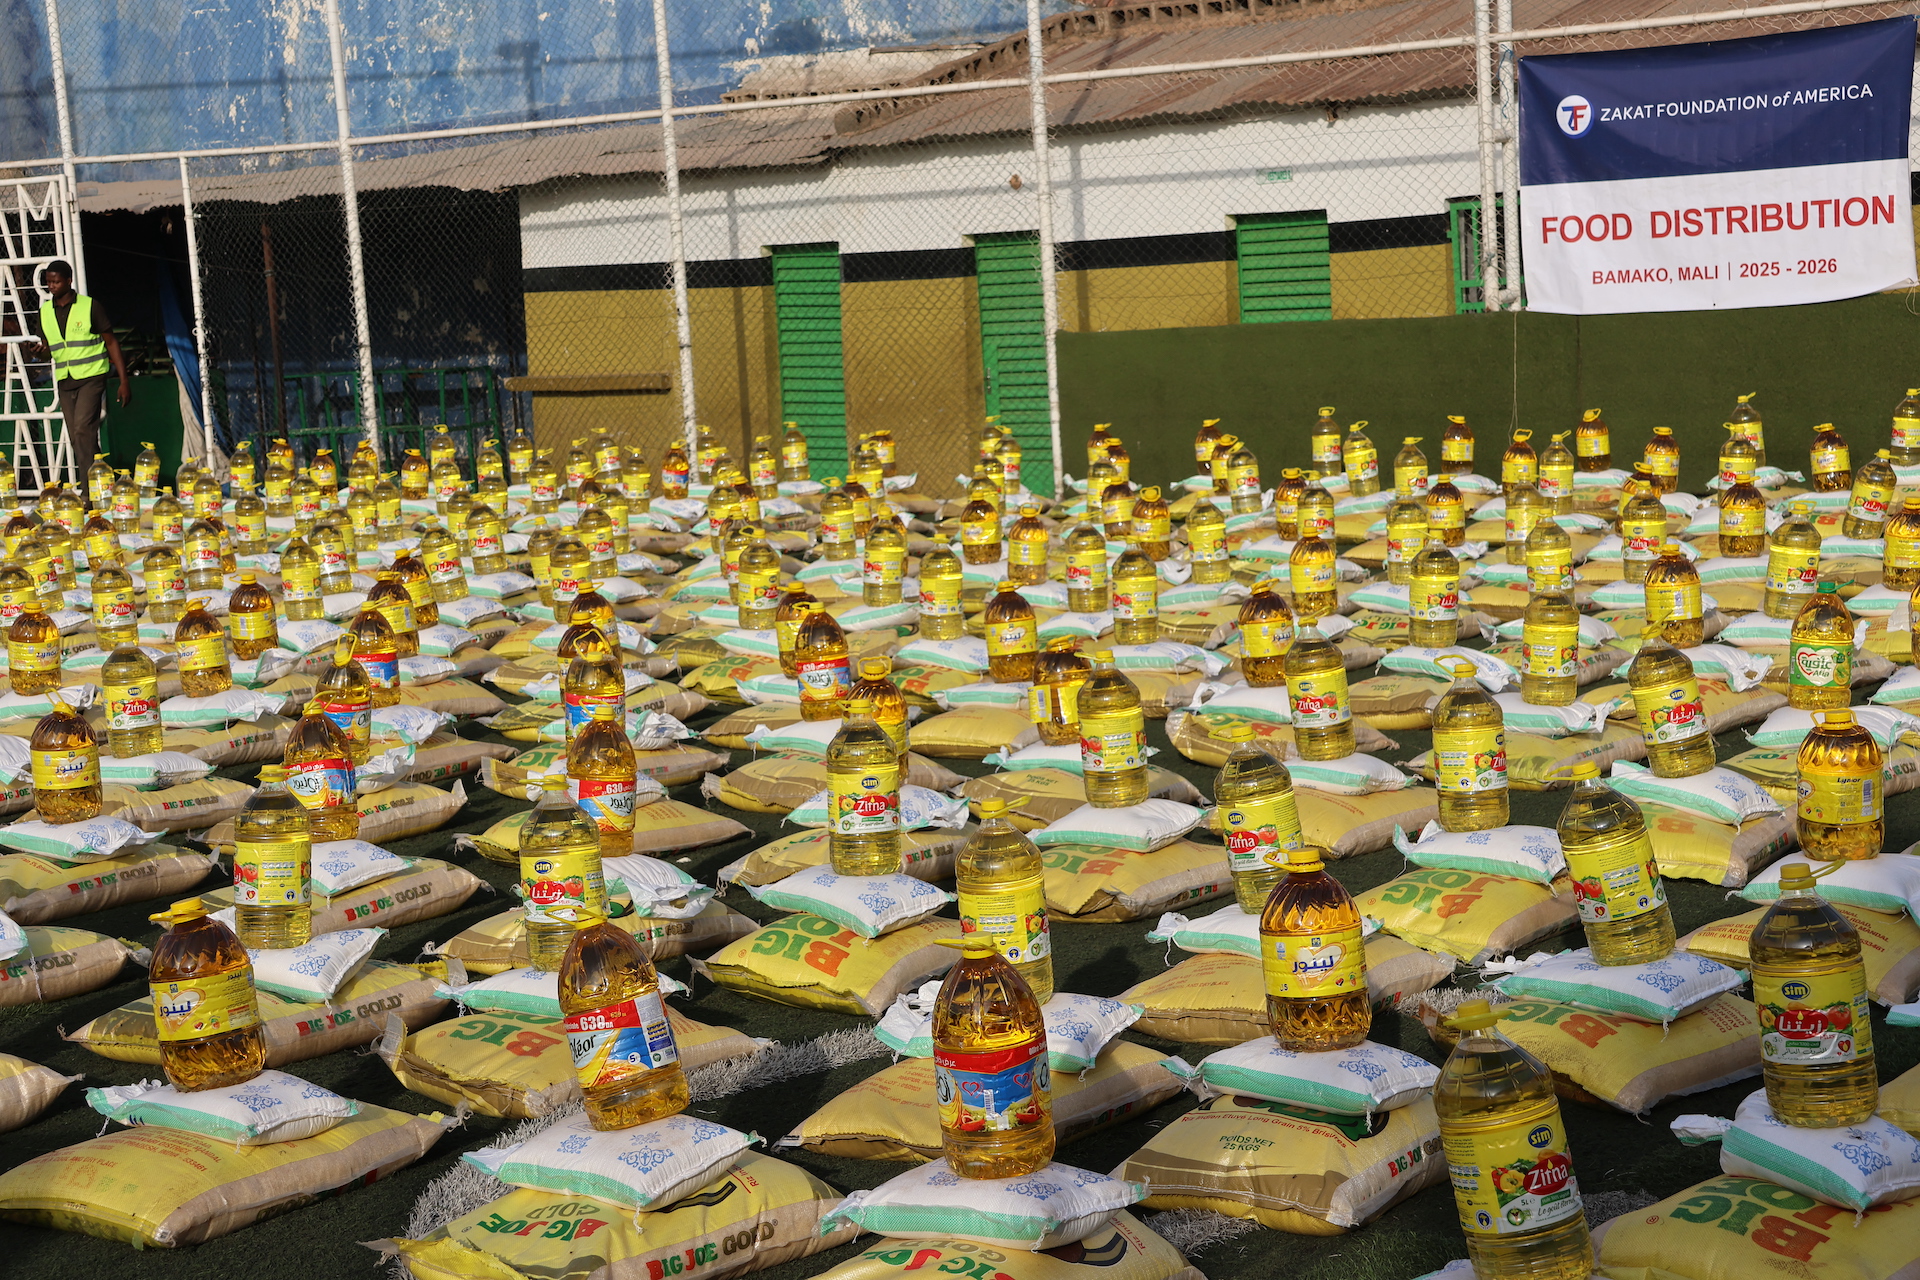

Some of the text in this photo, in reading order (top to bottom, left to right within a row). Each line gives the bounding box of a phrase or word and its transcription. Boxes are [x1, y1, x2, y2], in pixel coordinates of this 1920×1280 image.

[1600, 84, 1873, 122] ZAKAT FOUNDATION of AMERICA
[1542, 195, 1895, 244] FOOD DISTRIBUTION
[1592, 267, 1674, 285] BAMAKO,
[1678, 265, 1719, 281] MALI
[1739, 262, 1781, 278] 2025
[1797, 258, 1838, 275] 2026
[125, 704, 147, 714] Zitna
[1297, 700, 1321, 711] Zitna
[606, 783, 623, 793] 630
[862, 779, 878, 788] sim
[15, 787, 30, 798] JOE
[162, 798, 195, 810] BIG JOE
[856, 800, 885, 812] Zitna
[1229, 813, 1243, 822] sim
[1228, 836, 1256, 849] Zitna
[535, 862, 551, 871] sim
[905, 852, 920, 864] BIG
[67, 880, 94, 895] BIG
[96, 873, 118, 888] JOE
[344, 885, 432, 922] BIG JOE GOLD
[1381, 883, 1483, 920] BIG
[1858, 925, 1888, 942] MANDAL
[750, 929, 852, 978] BIG
[1292, 956, 1334, 973] لينور
[1784, 985, 1806, 995] sim
[160, 1001, 191, 1017] لينور
[295, 995, 403, 1037] BIG JOE GOLD
[580, 1015, 605, 1030] 630
[1779, 1016, 1822, 1034] زيتنا
[450, 1020, 563, 1057] BIG
[1248, 1115, 1270, 1123] Long
[1271, 1119, 1295, 1129] Grain
[1296, 1124, 1310, 1132] 5%
[1311, 1128, 1347, 1148] Brisures
[1530, 1130, 1551, 1145] sim
[1219, 1135, 1276, 1148] POIDS NET
[1237, 1143, 1261, 1151] KGS
[1388, 1156, 1408, 1177] BIG
[1528, 1164, 1569, 1190] Zitna
[525, 1202, 601, 1220] GOLD
[477, 1213, 609, 1242] BIG JOE
[1669, 1194, 1831, 1263] BIG
[645, 1221, 775, 1280] BIG JOE GOLD
